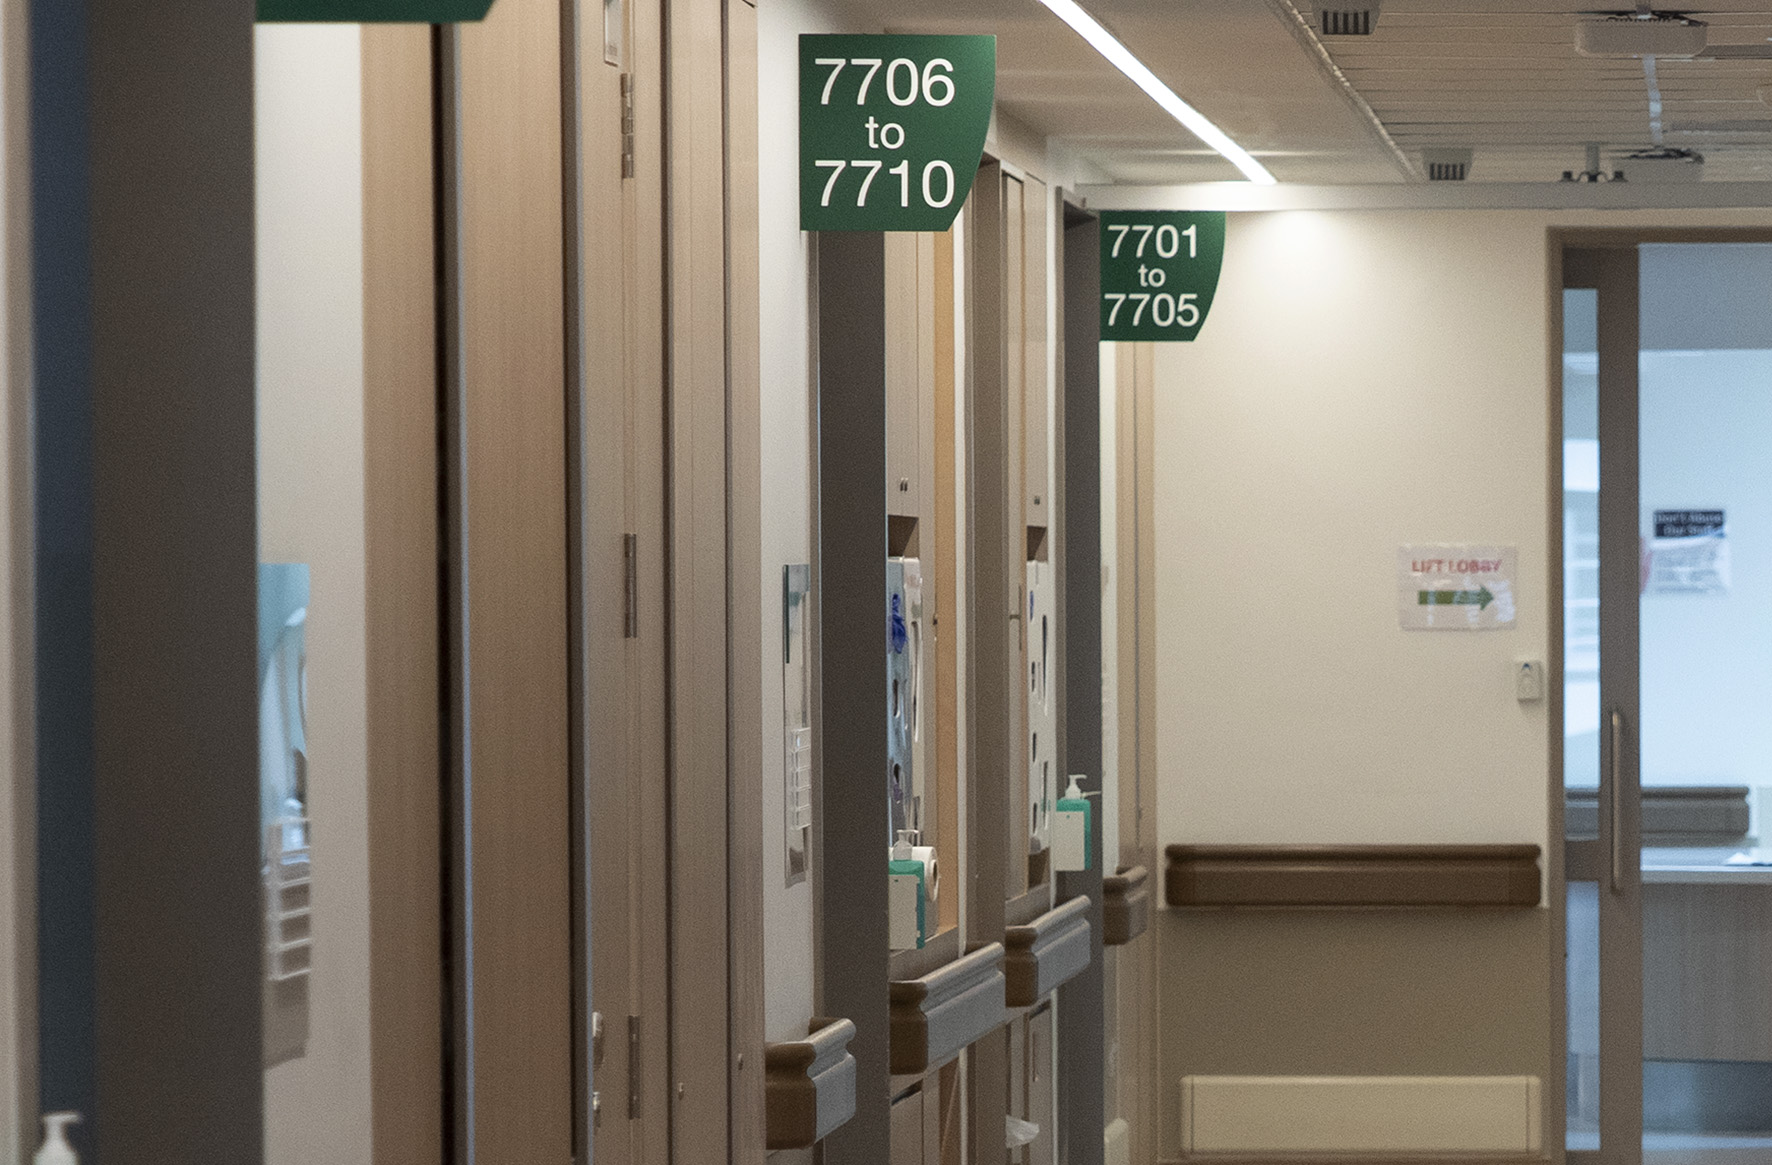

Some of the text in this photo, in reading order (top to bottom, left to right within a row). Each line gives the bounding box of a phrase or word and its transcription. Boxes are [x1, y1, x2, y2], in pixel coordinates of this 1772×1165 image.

[814, 57, 956, 107] 7706
[864, 115, 906, 150] to
[814, 159, 956, 208] 7710
[1107, 224, 1198, 259] 7701
[1137, 264, 1167, 288] to
[1104, 293, 1200, 327] 7705
[1411, 558, 1503, 574] LIFT LOBBY
